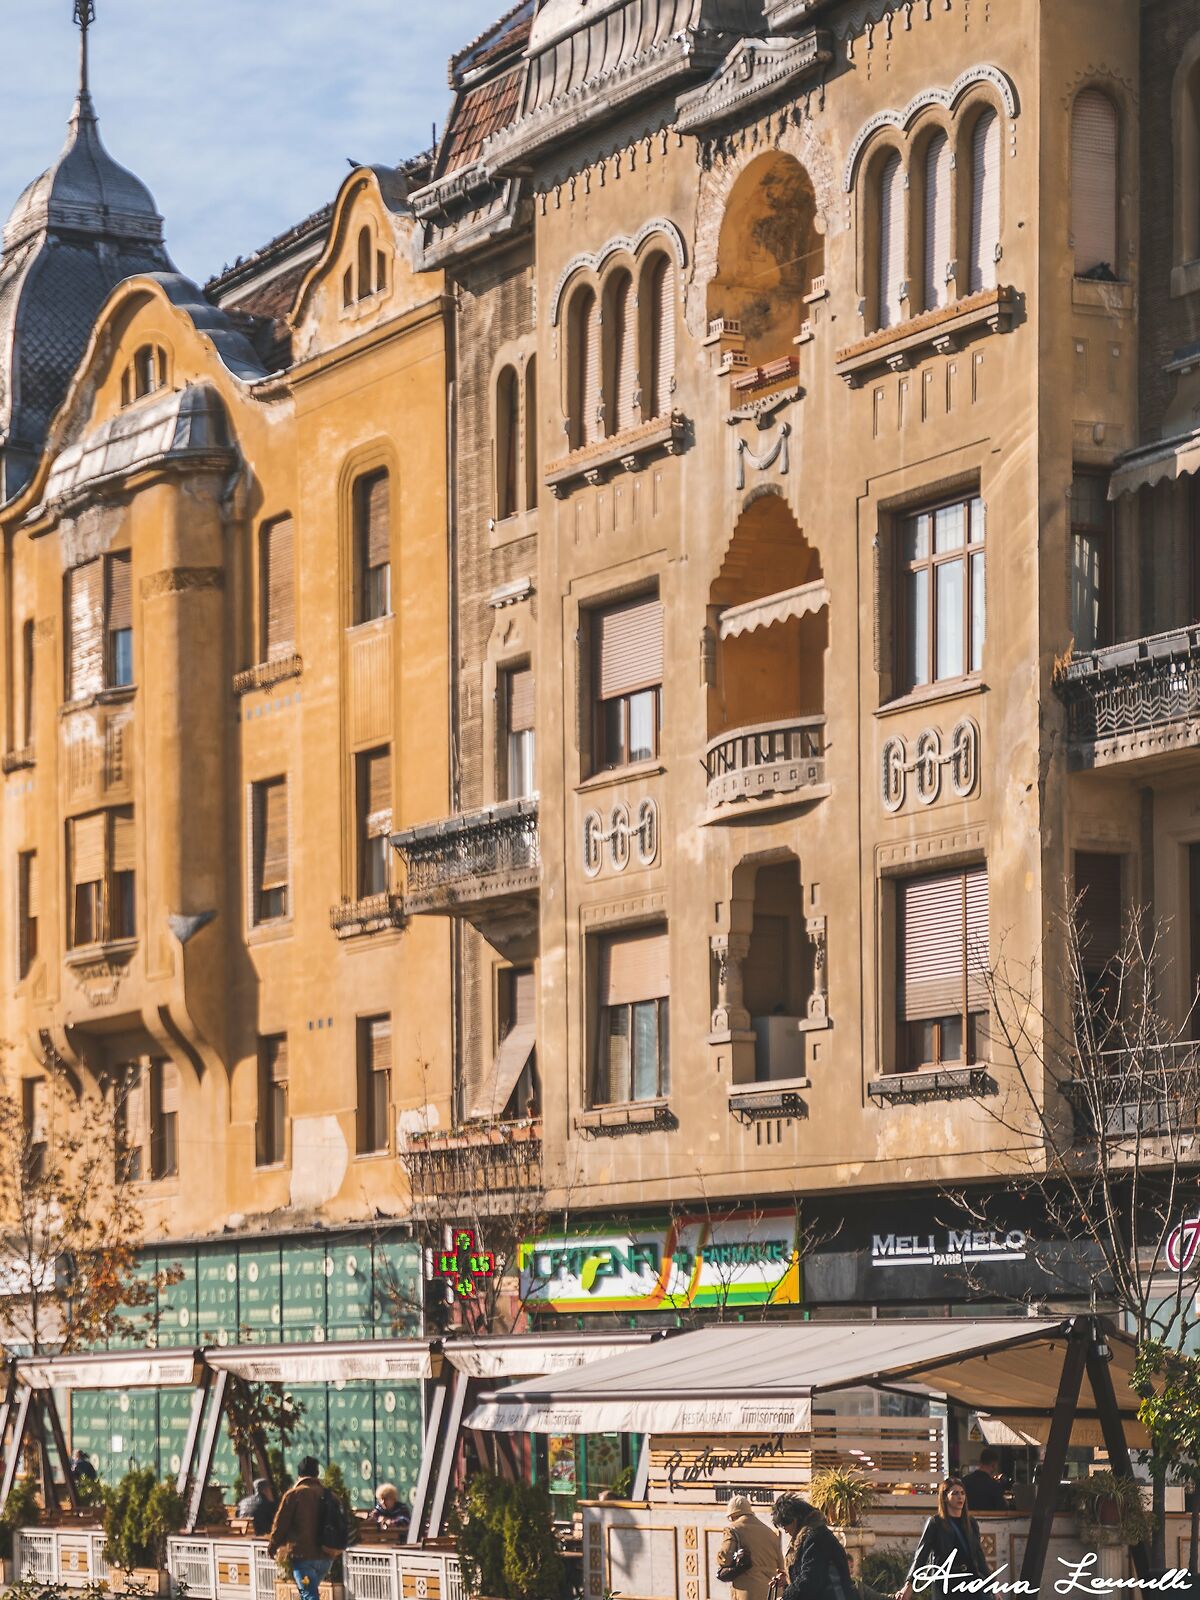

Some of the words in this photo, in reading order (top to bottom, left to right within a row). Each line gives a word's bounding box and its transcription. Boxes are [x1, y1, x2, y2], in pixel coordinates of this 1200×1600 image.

[872, 1233, 936, 1256] MELI
[947, 1229, 1026, 1252] MELO
[932, 1254, 963, 1266] PARIS
[682, 1412, 732, 1425] RESTAURANT
